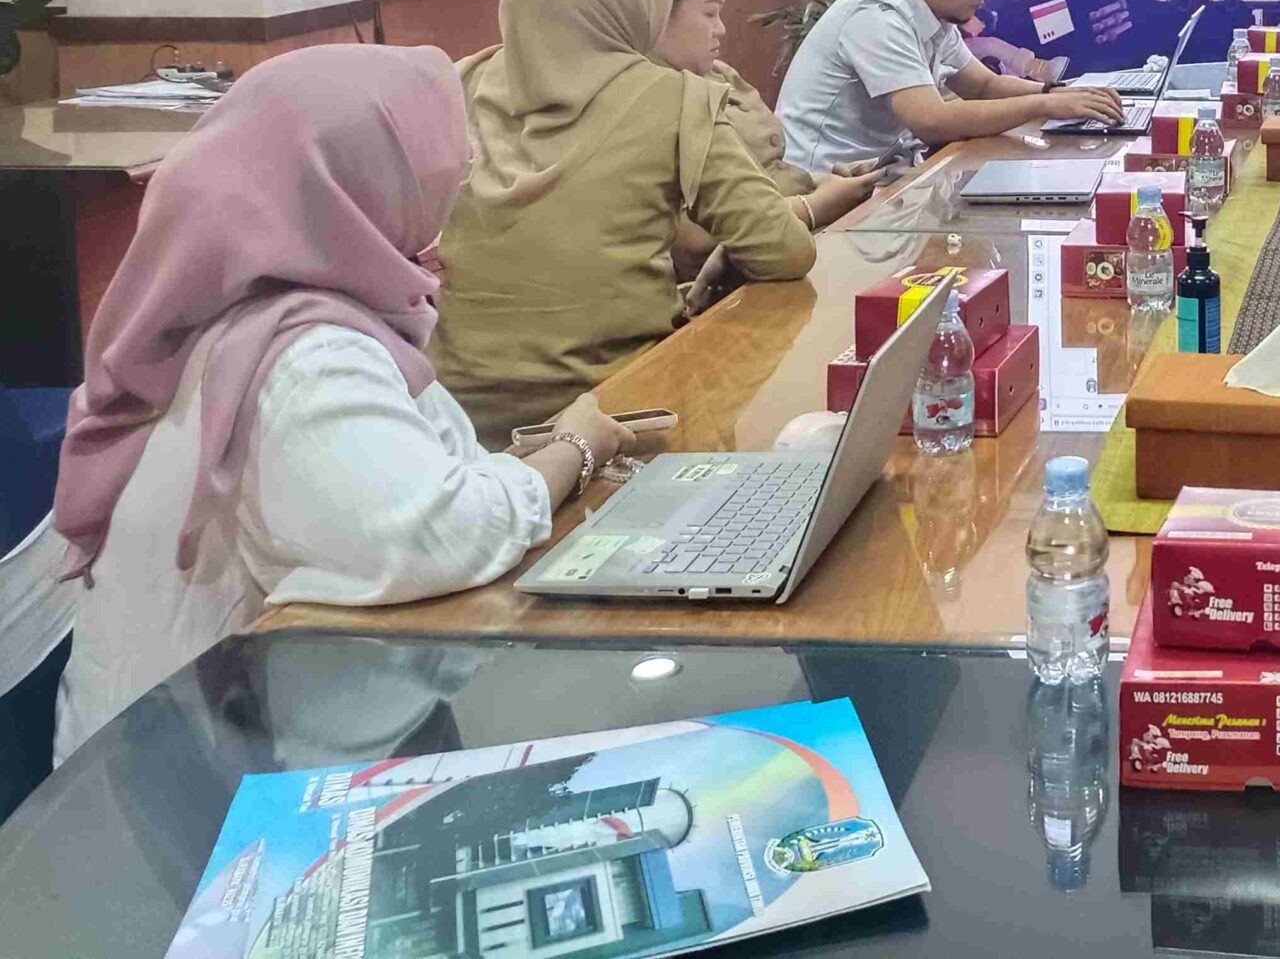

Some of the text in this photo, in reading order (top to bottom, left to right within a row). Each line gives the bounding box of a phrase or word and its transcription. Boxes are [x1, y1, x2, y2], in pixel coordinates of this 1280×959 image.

[1132, 276, 1163, 285] Minerale
[1209, 596, 1233, 608] Free
[1209, 608, 1254, 623] Delivery
[1133, 691, 1151, 703] WA
[1166, 751, 1189, 762] Free
[1166, 762, 1209, 775] Delivery
[317, 771, 353, 806] DINAS
[346, 806, 376, 842] DINAS
[339, 840, 374, 912] KOMUNIKASI
[336, 909, 368, 936] DAN
